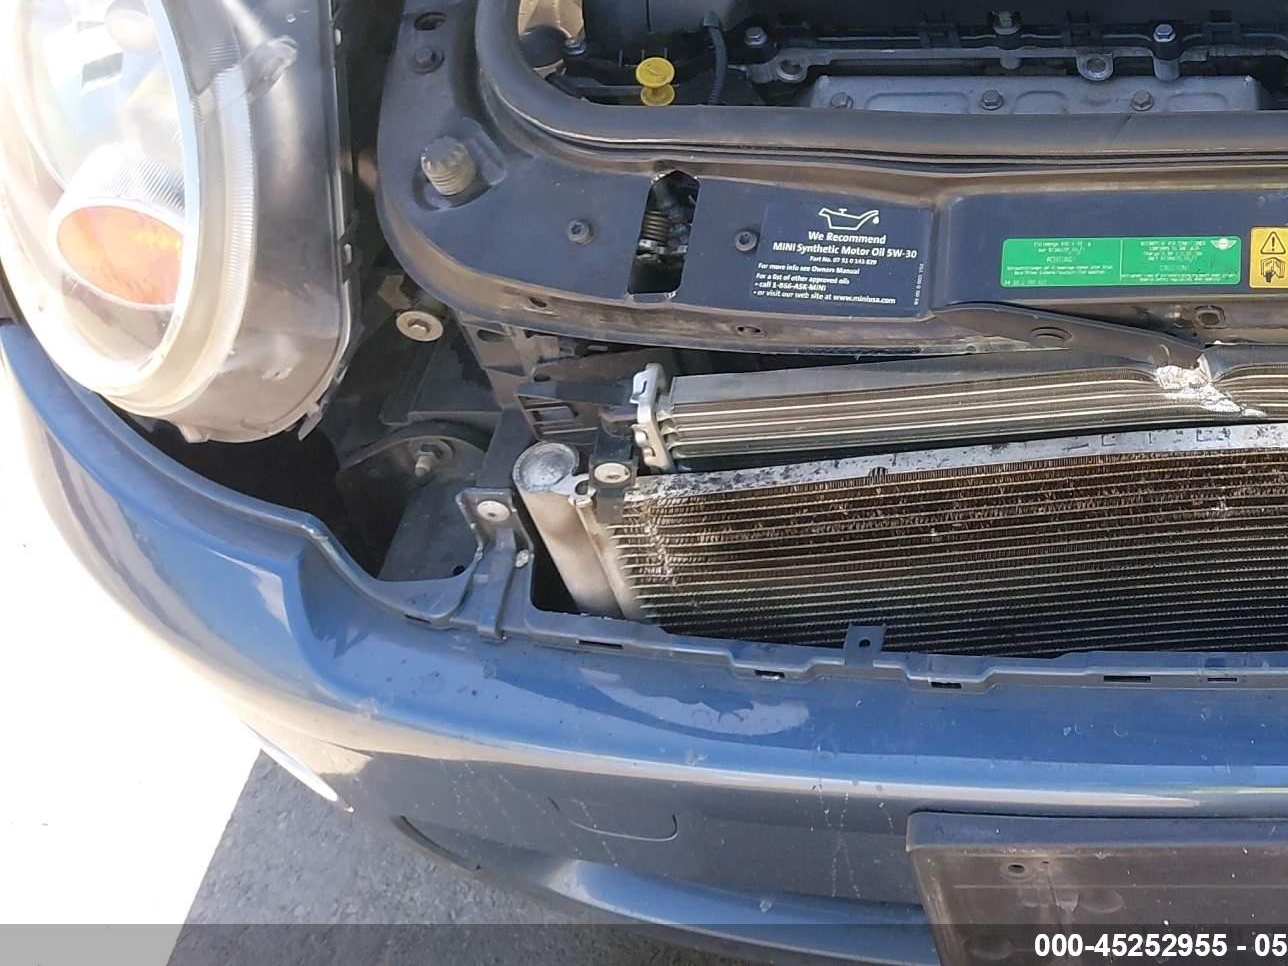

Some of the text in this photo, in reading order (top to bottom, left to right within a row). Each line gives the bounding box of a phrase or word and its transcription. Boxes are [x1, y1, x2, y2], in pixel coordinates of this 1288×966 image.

[808, 231, 887, 244] We Recommend
[773, 242, 917, 259] MINI Synthetic Motor Oil 5W-30
[786, 263, 799, 271] info
[811, 265, 835, 273] Owners
[808, 276, 838, 284] approved
[838, 277, 850, 285] oils
[766, 289, 781, 297] visit
[810, 292, 824, 300] site
[833, 295, 896, 304] www.miniusa.com
